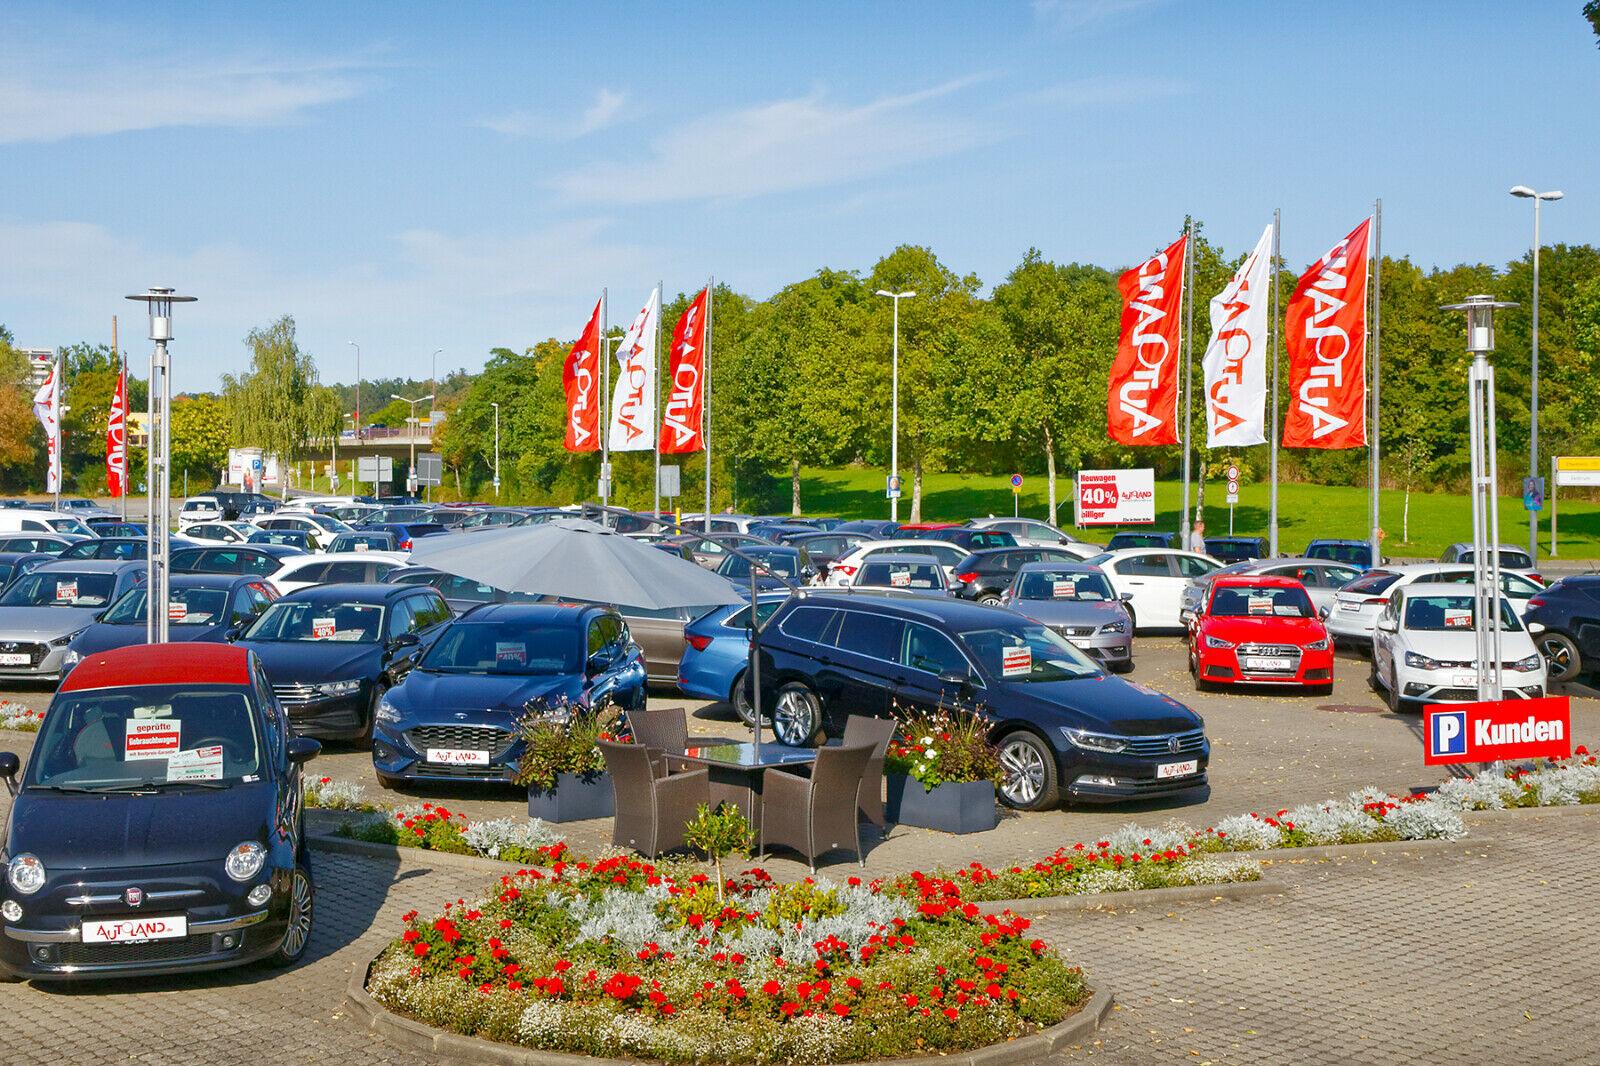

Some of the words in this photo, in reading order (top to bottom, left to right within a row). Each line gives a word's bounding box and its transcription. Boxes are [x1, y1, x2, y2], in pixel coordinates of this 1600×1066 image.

[136, 723, 171, 732] geprüfte
[1439, 715, 1460, 752] P
[1474, 716, 1563, 746] Kunden
